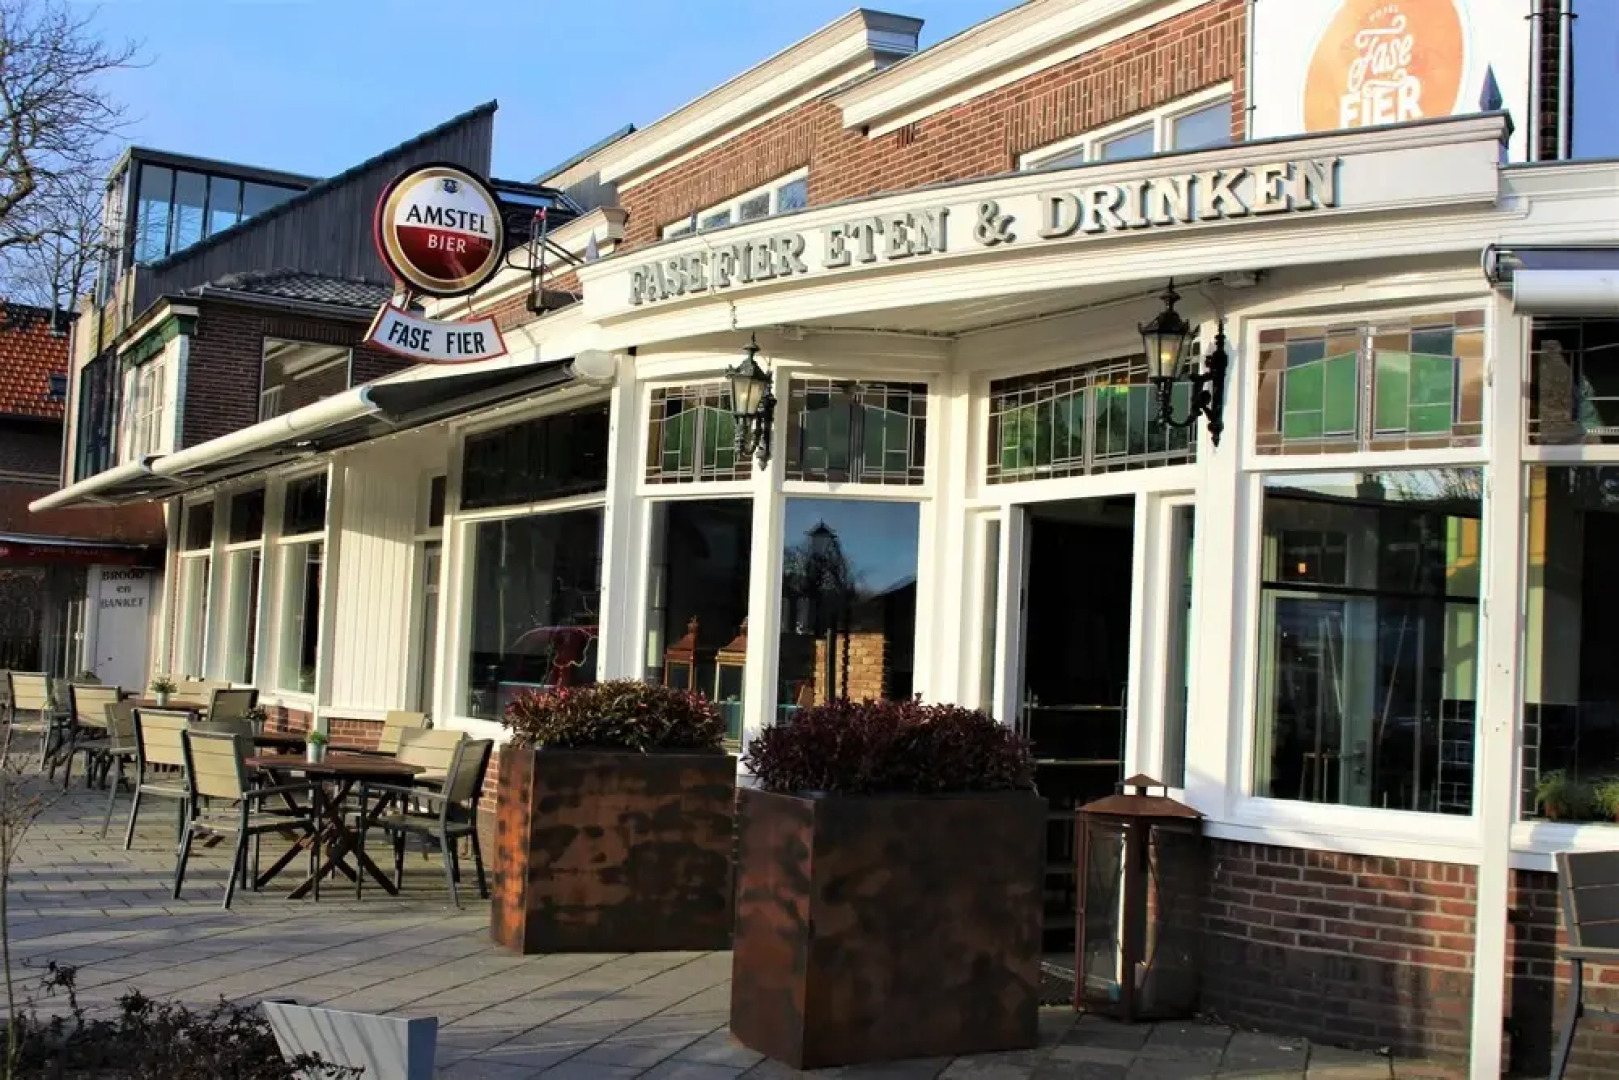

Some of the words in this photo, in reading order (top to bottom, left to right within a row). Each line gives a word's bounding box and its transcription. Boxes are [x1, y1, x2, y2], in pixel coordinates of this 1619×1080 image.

[1339, 75, 1423, 129] FIER
[406, 204, 489, 235] AMSTEL
[820, 206, 950, 269] ETEN
[973, 199, 1016, 247] &
[1037, 156, 1344, 239] DRINKEN
[427, 234, 467, 254] BIER
[388, 320, 432, 352] FASE
[446, 331, 486, 354] FIER
[101, 570, 146, 581] BROOD
[116, 585, 132, 594] en
[100, 597, 145, 609] BANKET
